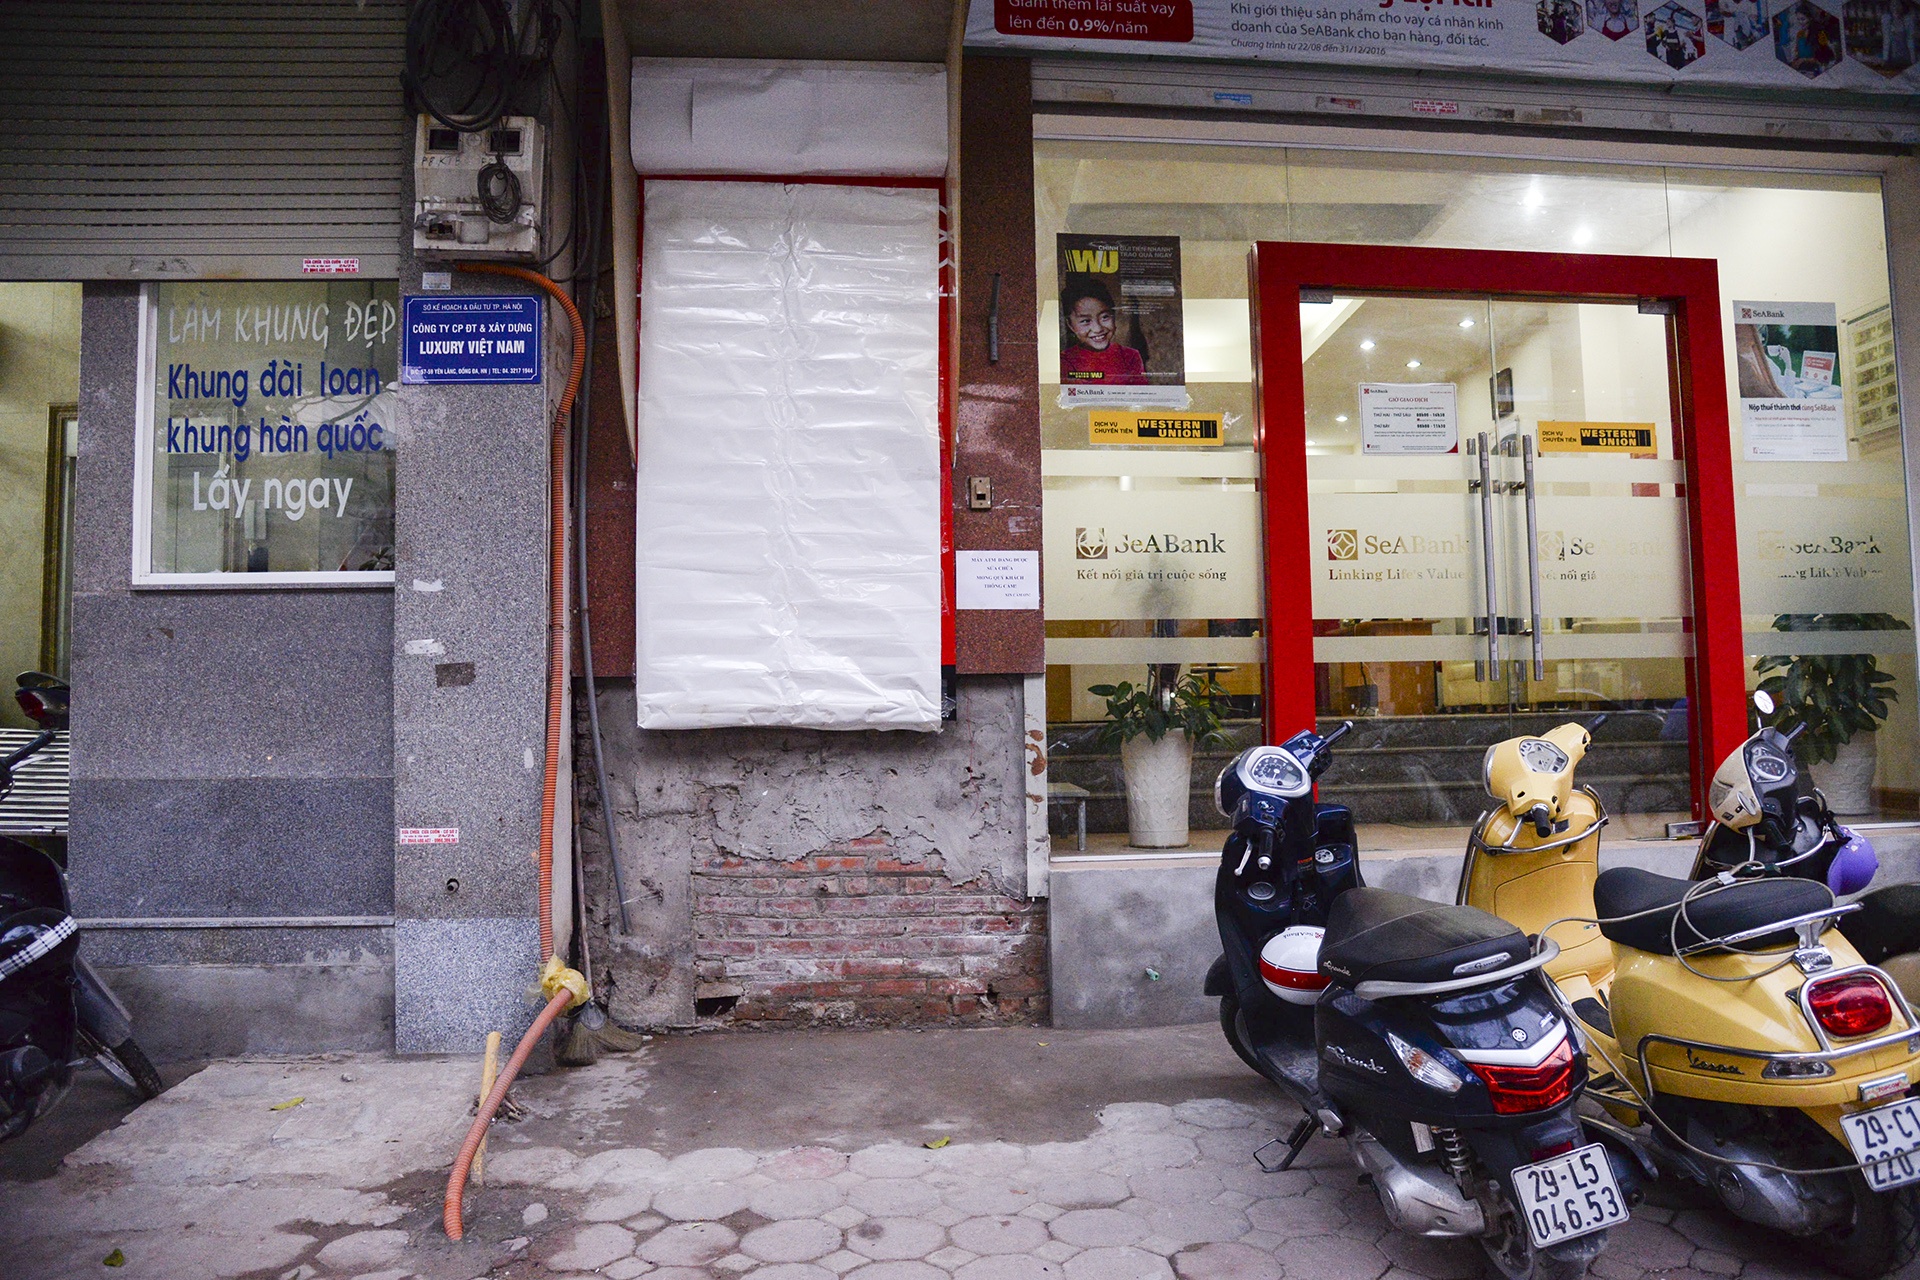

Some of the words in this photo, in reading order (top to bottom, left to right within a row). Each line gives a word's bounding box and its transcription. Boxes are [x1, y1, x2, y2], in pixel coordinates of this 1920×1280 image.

[1151, 4, 1176, 17] vay
[1230, 3, 1250, 14] Khi
[1254, 5, 1277, 18] giới
[1281, 6, 1313, 20] thiệu
[1316, 9, 1337, 19] sản
[1341, 9, 1376, 22] phẩm
[1379, 12, 1401, 23] cho
[1404, 15, 1425, 27] vay
[1428, 14, 1441, 26] cá
[1444, 16, 1474, 28] nhân
[1478, 17, 1504, 30] kinh
[1009, 14, 1032, 29] lên
[1036, 16, 1065, 30] đến
[1069, 19, 1148, 34] 0.9%/năm
[1231, 20, 1272, 33] doanh
[1275, 23, 1297, 35] của
[1300, 24, 1355, 38] SeABank
[1357, 28, 1380, 39] cho
[1383, 29, 1406, 43] bạn
[1409, 31, 1443, 46] hàng,
[1446, 33, 1465, 45] đối
[1468, 35, 1489, 46] tác.
[1231, 39, 1264, 51] Chương
[1266, 41, 1286, 50] trình
[1287, 41, 1297, 50] từ
[1298, 43, 1321, 52] 22/08
[1322, 44, 1338, 53] đến
[1339, 45, 1386, 56] 31/12/2016
[1071, 250, 1119, 274] WU
[235, 303, 330, 349] KHUNG
[344, 299, 396, 348] ĐẸP
[412, 322, 436, 333] CÔNG
[439, 324, 450, 333] TY
[452, 324, 464, 333] CP
[465, 324, 477, 333] ĐT
[480, 324, 486, 333] &
[488, 322, 506, 333] XÂY
[508, 322, 533, 334] DỰNG
[420, 341, 465, 355] LUXURY
[468, 337, 493, 357] VIỆT
[496, 340, 525, 354] NAM
[168, 363, 248, 407] Khung
[259, 359, 303, 397] đài
[320, 361, 380, 397] loan
[1138, 419, 1200, 429] WESTERN
[1158, 429, 1200, 438] UNION
[1581, 429, 1636, 438] WESTERN
[167, 417, 251, 463] khung
[259, 415, 308, 453] hàn
[317, 410, 384, 460] quốc
[1599, 438, 1637, 446] UNION
[193, 464, 251, 518] Lấy
[264, 477, 353, 521] ngay
[1115, 533, 1226, 553] SeABank
[1364, 534, 1471, 554] SeABank
[1077, 568, 1098, 580] Kết
[1102, 568, 1121, 580] nối
[1125, 569, 1144, 582] giá
[1148, 569, 1163, 582] trị
[1166, 569, 1195, 582] cuộc
[1199, 568, 1227, 582] sống
[1328, 569, 1383, 582] Linking
[1387, 568, 1423, 580] Life's
[1427, 569, 1472, 580] Value
[1560, 568, 1578, 580] nối
[1580, 570, 1597, 582] giá
[1335, 1045, 1388, 1074] Grande
[1687, 1048, 1745, 1075] Vespa
[1855, 1105, 1920, 1149] 29-C1
[1527, 1152, 1600, 1203] 29-L5
[1532, 1186, 1620, 1240] 046.53
